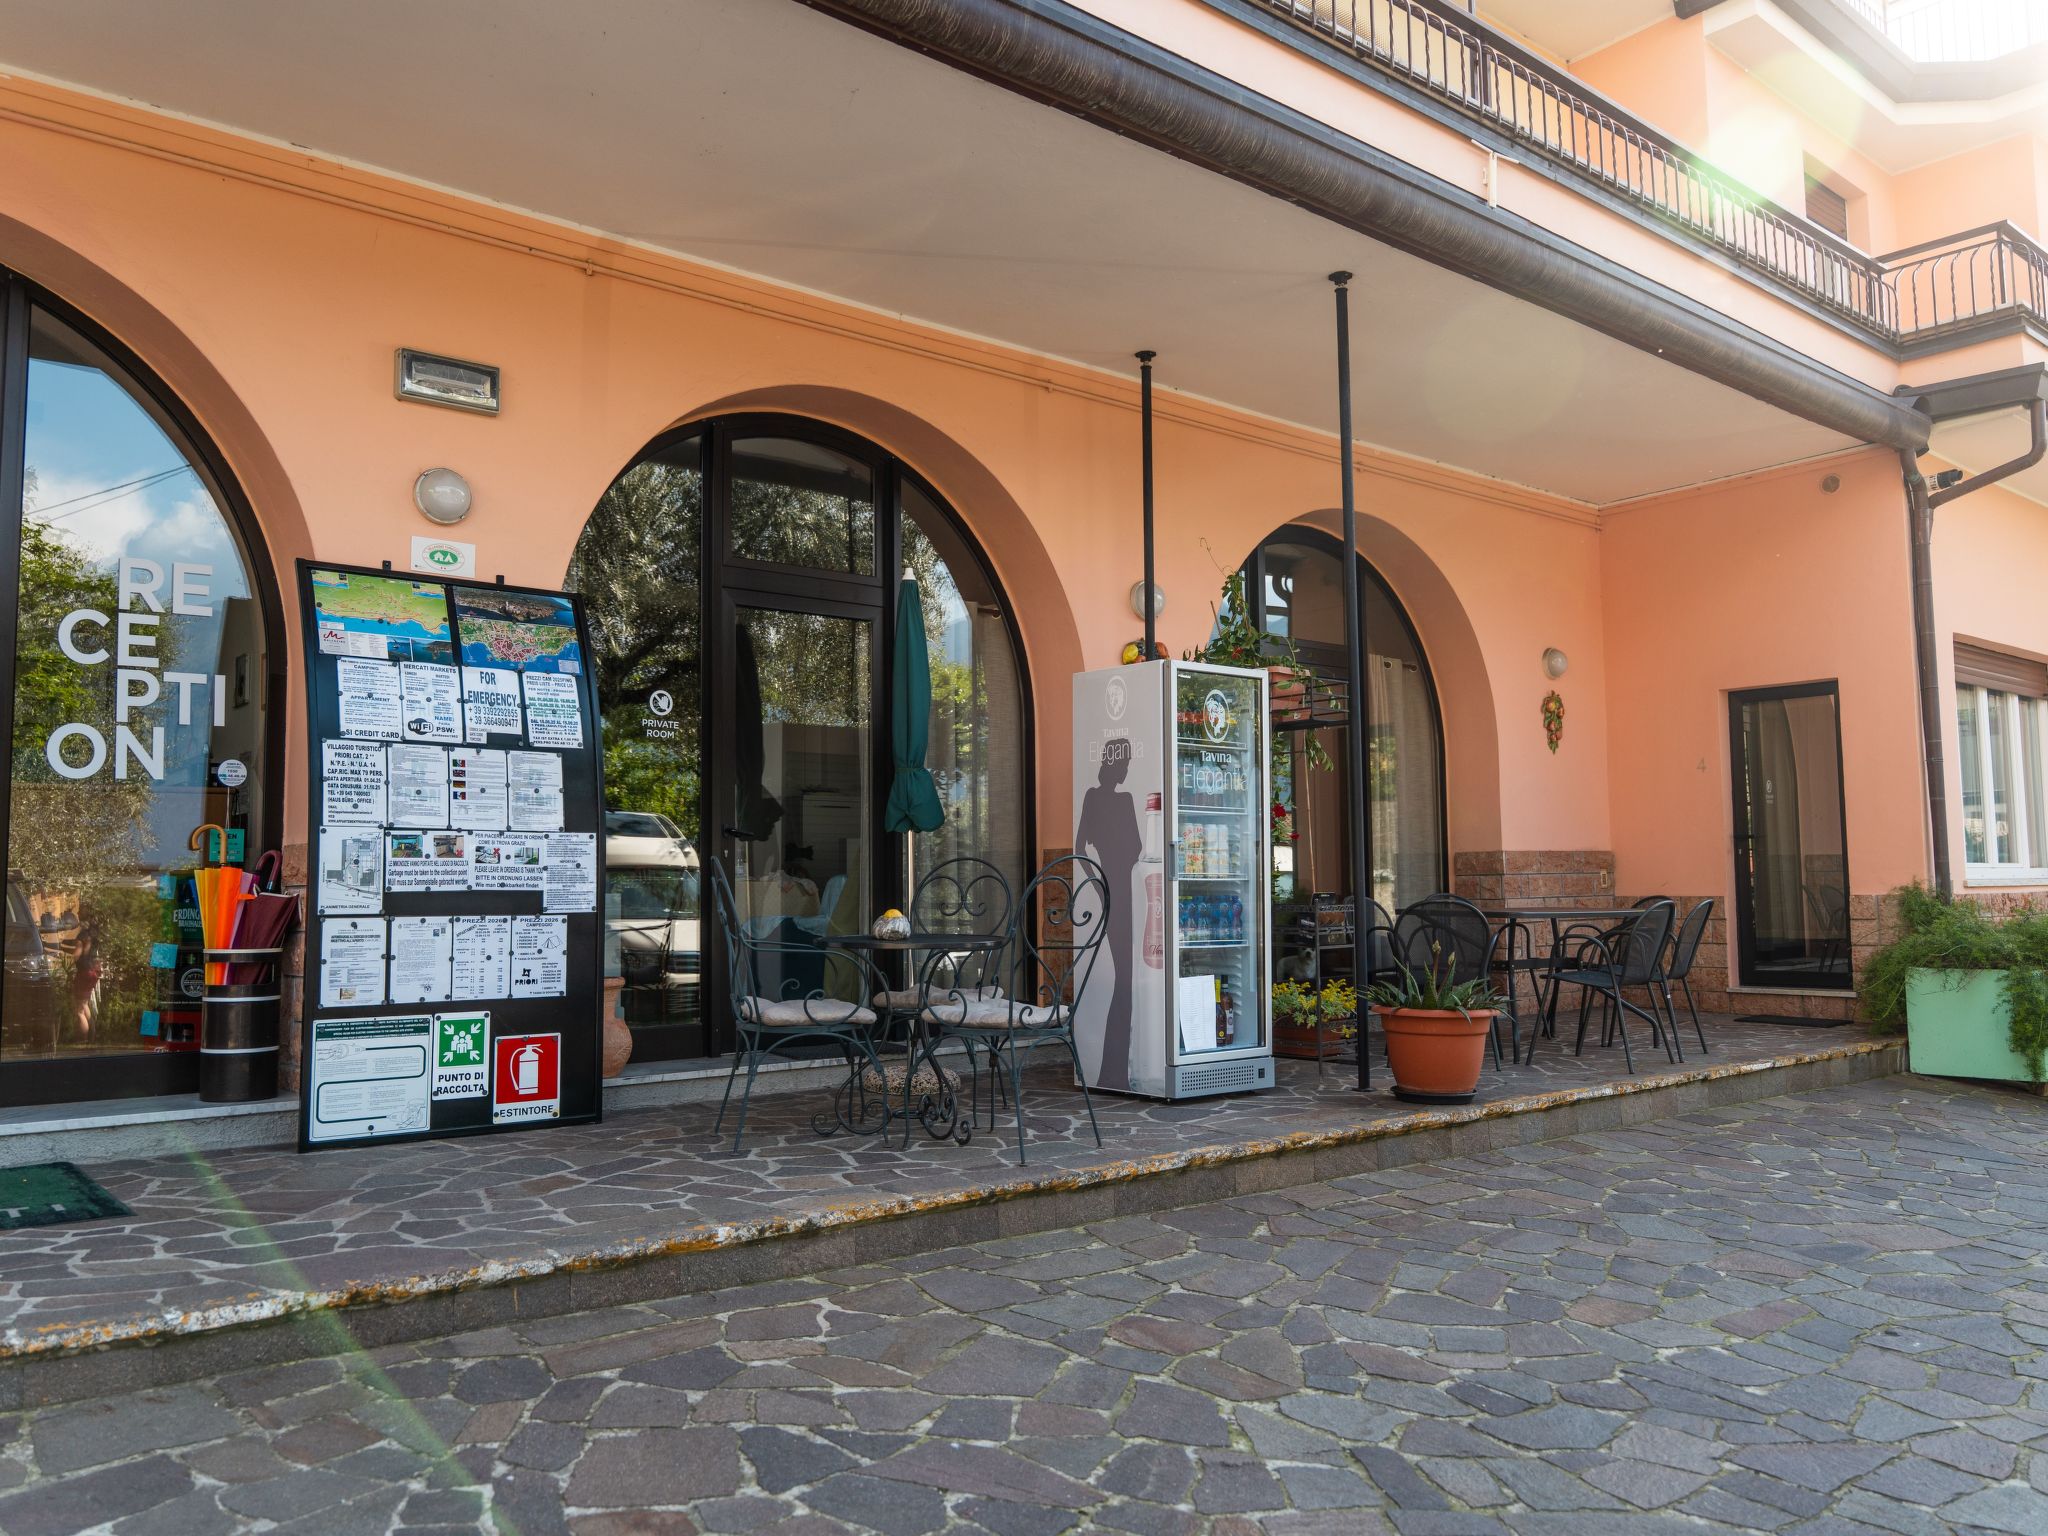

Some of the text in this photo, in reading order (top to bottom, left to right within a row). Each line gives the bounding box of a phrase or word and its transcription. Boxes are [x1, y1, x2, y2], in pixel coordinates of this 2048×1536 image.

[118, 557, 213, 617] RE
[58, 608, 160, 668] CE
[480, 671, 496, 685] FOR
[116, 668, 226, 727] PTI
[467, 690, 517, 707] EMERGENCY
[473, 705, 482, 715] 39
[474, 715, 482, 725] 39
[642, 718, 680, 729] PRIVATE
[381, 731, 400, 739] CARD
[646, 729, 675, 739] ROOM
[46, 722, 165, 780] ON
[326, 743, 382, 752] VILLAGGIO TURISTICO
[1089, 736, 1144, 766] Elegantia
[1200, 750, 1232, 763] Tavina
[1183, 763, 1248, 796] Elegantia
[388, 869, 404, 877] Garbage
[457, 869, 468, 877] point
[173, 908, 200, 922] ERDING
[438, 1072, 484, 1082] PUNTO DI
[437, 1084, 485, 1094] RACCOLTA
[500, 1105, 553, 1117] ESTINTORE
